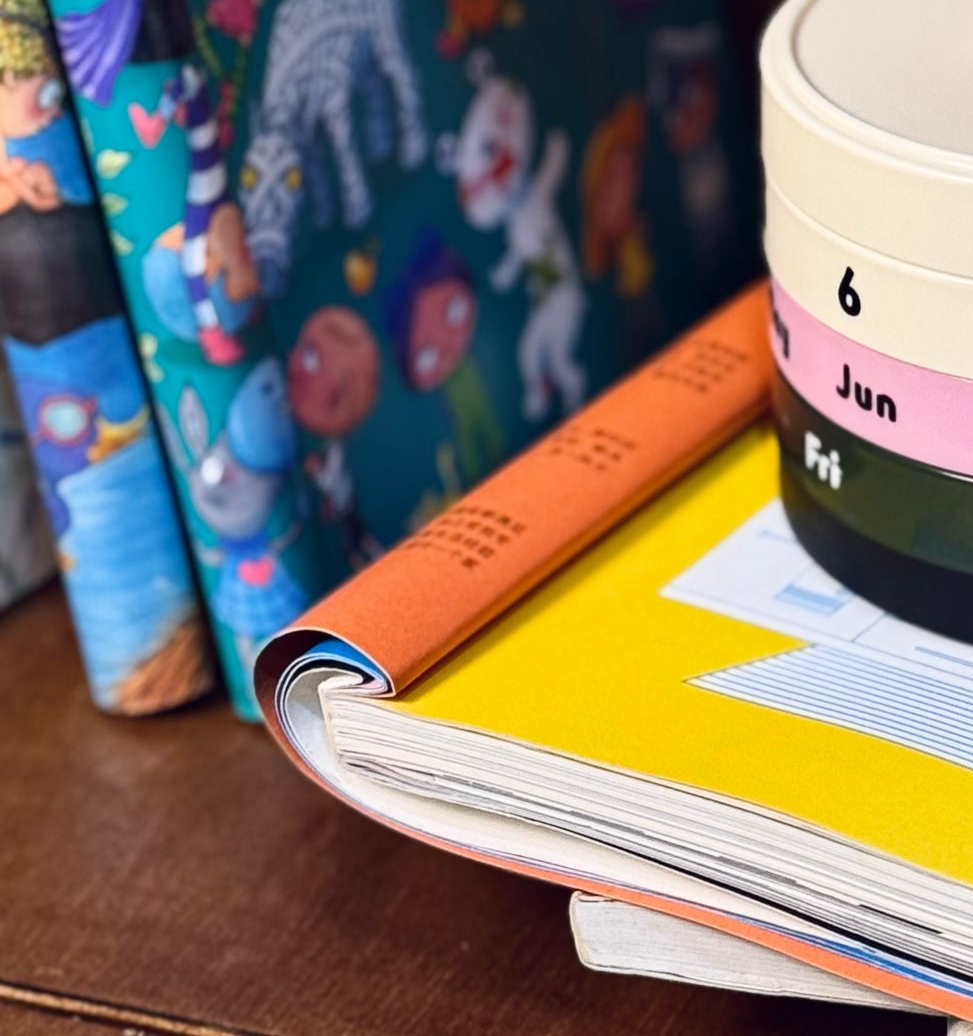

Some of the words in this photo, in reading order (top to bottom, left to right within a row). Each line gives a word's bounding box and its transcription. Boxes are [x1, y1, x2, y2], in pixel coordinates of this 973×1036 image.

[837, 266, 862, 317] 6
[835, 363, 897, 423] Jun
[804, 430, 842, 490] Fri
